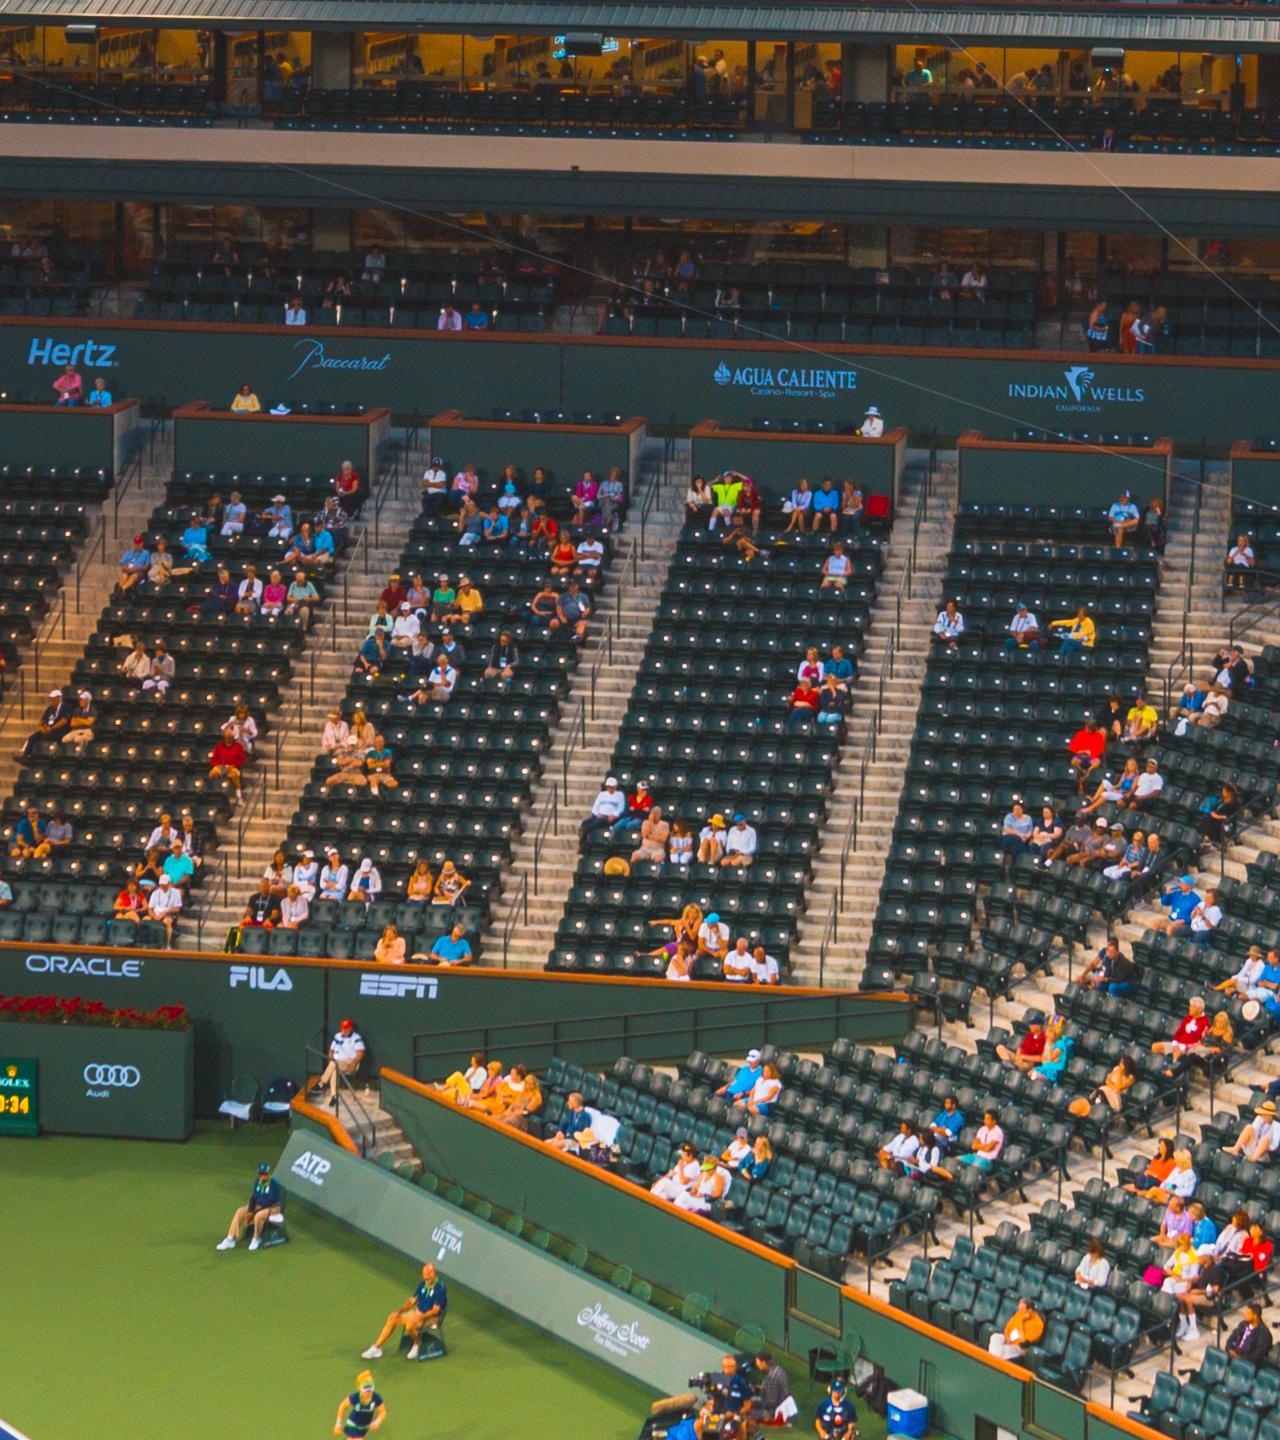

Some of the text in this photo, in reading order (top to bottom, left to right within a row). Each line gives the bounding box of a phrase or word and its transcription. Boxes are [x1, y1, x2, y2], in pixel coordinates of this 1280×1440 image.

[27, 338, 117, 368] Hertz
[287, 339, 392, 381] Baccarat
[732, 367, 857, 390] AGUA CALIENTE
[1008, 384, 1145, 402] INDIAN WELLS
[1055, 404, 1102, 414] CALIFORNIA
[25, 954, 141, 978] ORACLE
[229, 966, 293, 991] FILA
[359, 973, 439, 999] ESPN
[85, 1088, 110, 1098] Audi
[294, 1151, 332, 1175] ATP
[431, 1227, 462, 1254] ULTRA
